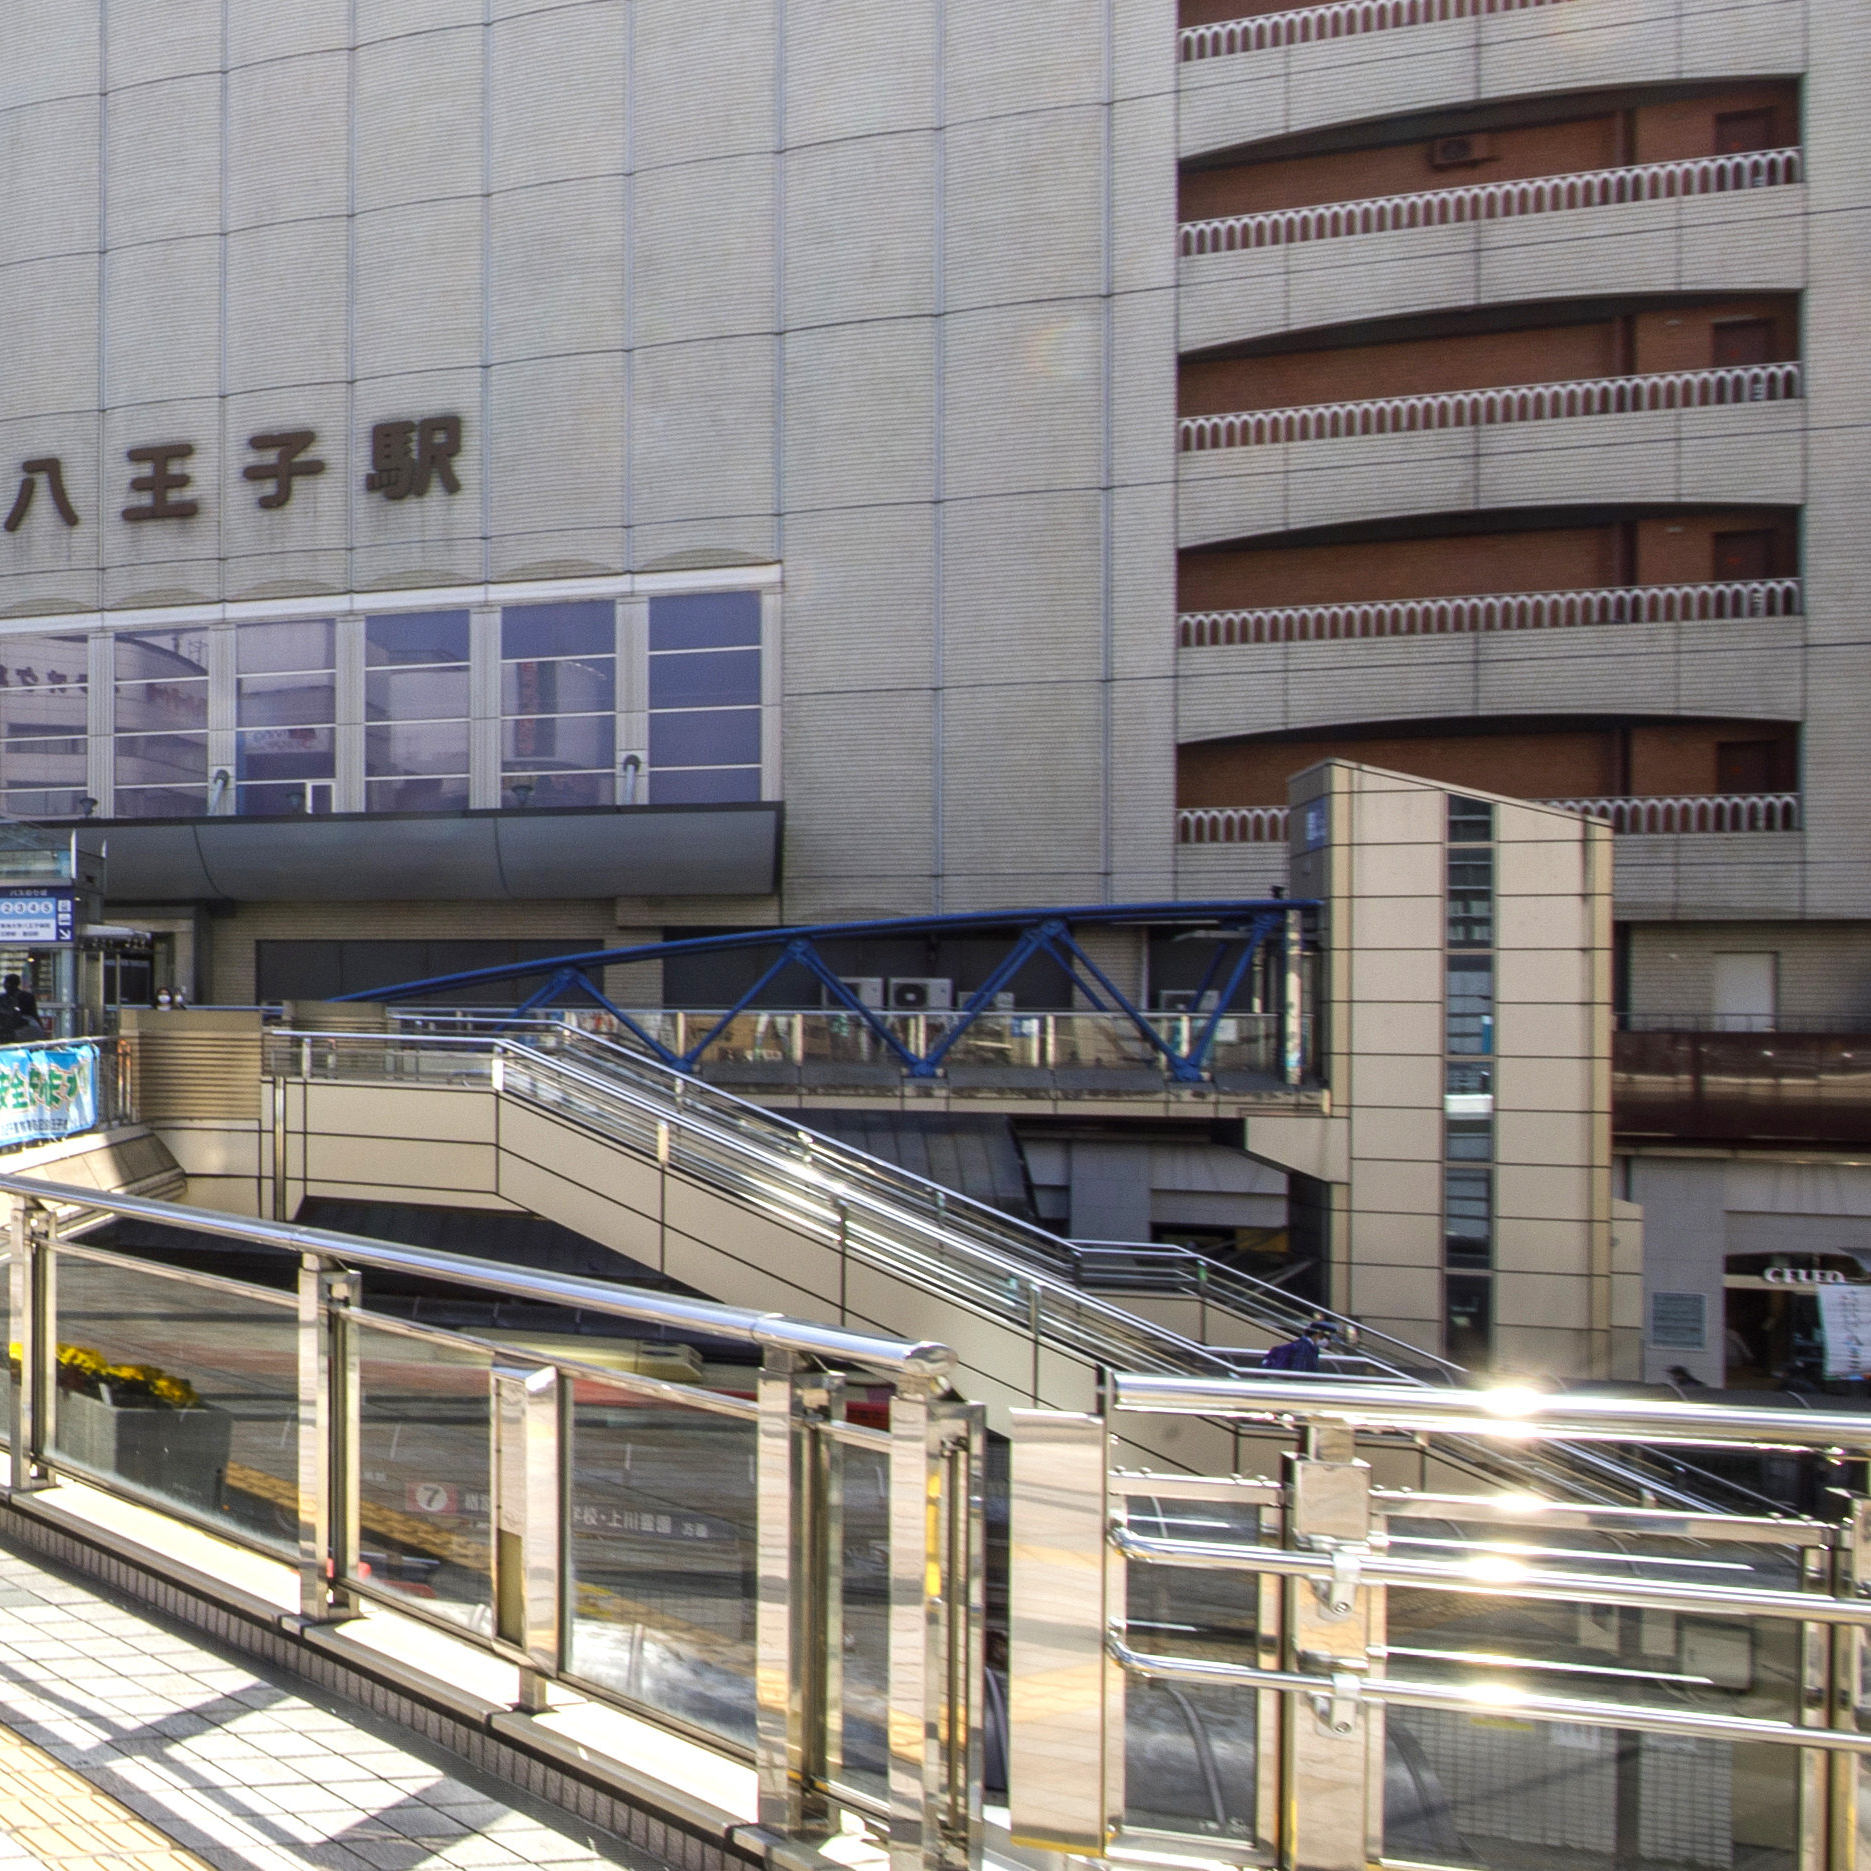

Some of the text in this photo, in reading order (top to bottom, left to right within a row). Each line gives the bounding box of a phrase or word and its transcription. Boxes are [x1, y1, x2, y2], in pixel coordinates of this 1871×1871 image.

[4, 414, 462, 532] 八王子駅
[1763, 1267, 1847, 1283] CELEO
[423, 1485, 441, 1508] 7
